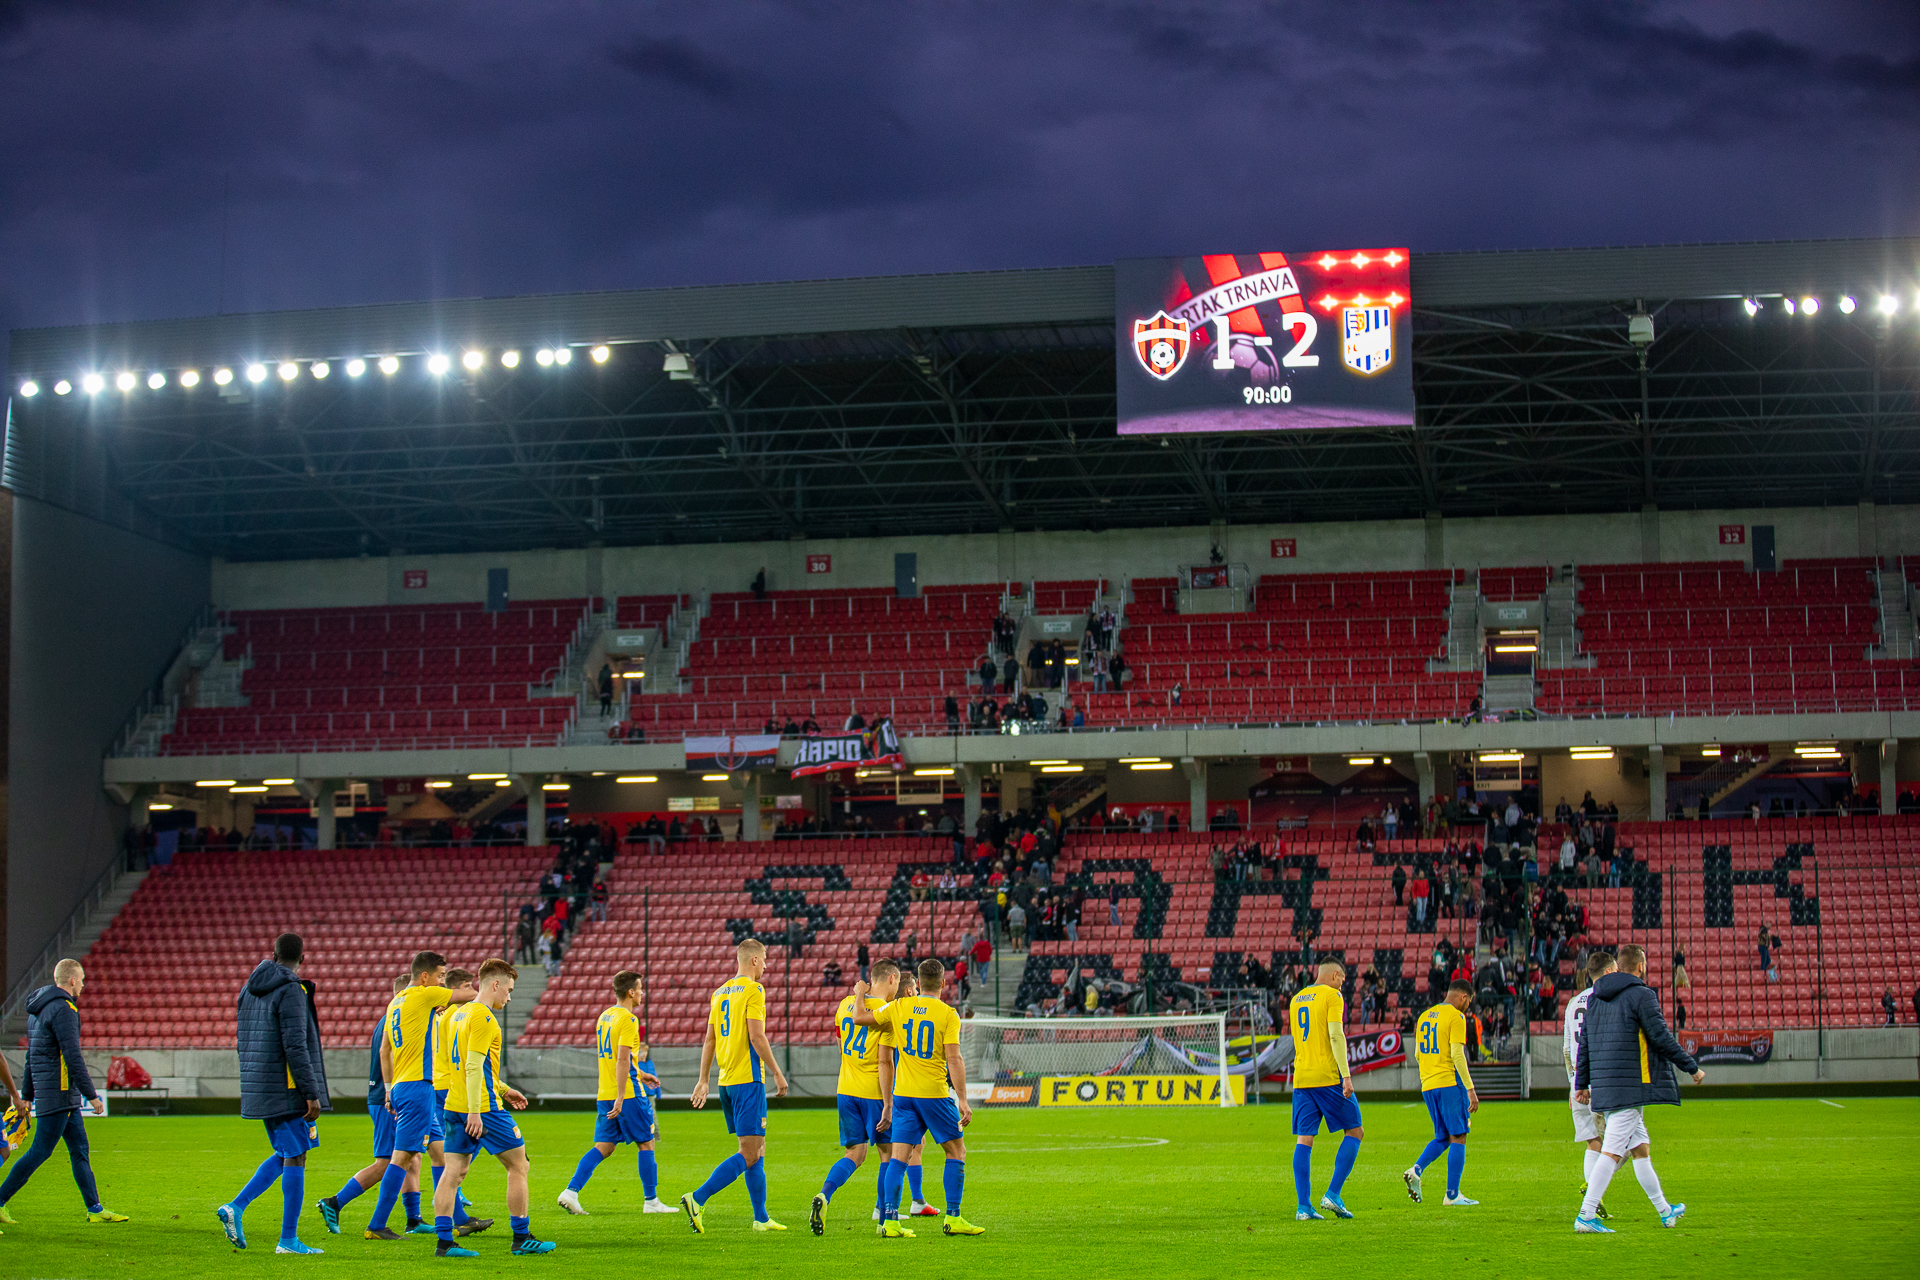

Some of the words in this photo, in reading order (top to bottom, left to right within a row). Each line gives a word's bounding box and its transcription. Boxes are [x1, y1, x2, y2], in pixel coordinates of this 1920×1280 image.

[1173, 292, 1224, 327] RTAK
[1224, 272, 1294, 306] TRNAVA
[1212, 316, 1235, 370] 1
[1282, 312, 1320, 367] 2
[1243, 386, 1291, 404] 90:00
[1724, 533, 1740, 543] 32
[1276, 546, 1290, 557] 31
[812, 562, 827, 572] 30
[409, 578, 422, 588] 29
[1276, 761, 1292, 771] 03
[1736, 749, 1752, 760] 04
[825, 772, 841, 781] 02
[721, 999, 730, 1037] 3
[912, 1005, 928, 1015] VIDA
[392, 1008, 403, 1048] 8
[1298, 1006, 1310, 1042] 9
[452, 1028, 461, 1071] 4
[597, 1025, 613, 1060] 14
[841, 1016, 869, 1060] 24
[902, 1018, 935, 1060] 10
[1420, 1021, 1440, 1055] 31
[996, 1089, 1025, 1100] Sport
[1052, 1079, 1229, 1102] FORTUNA
